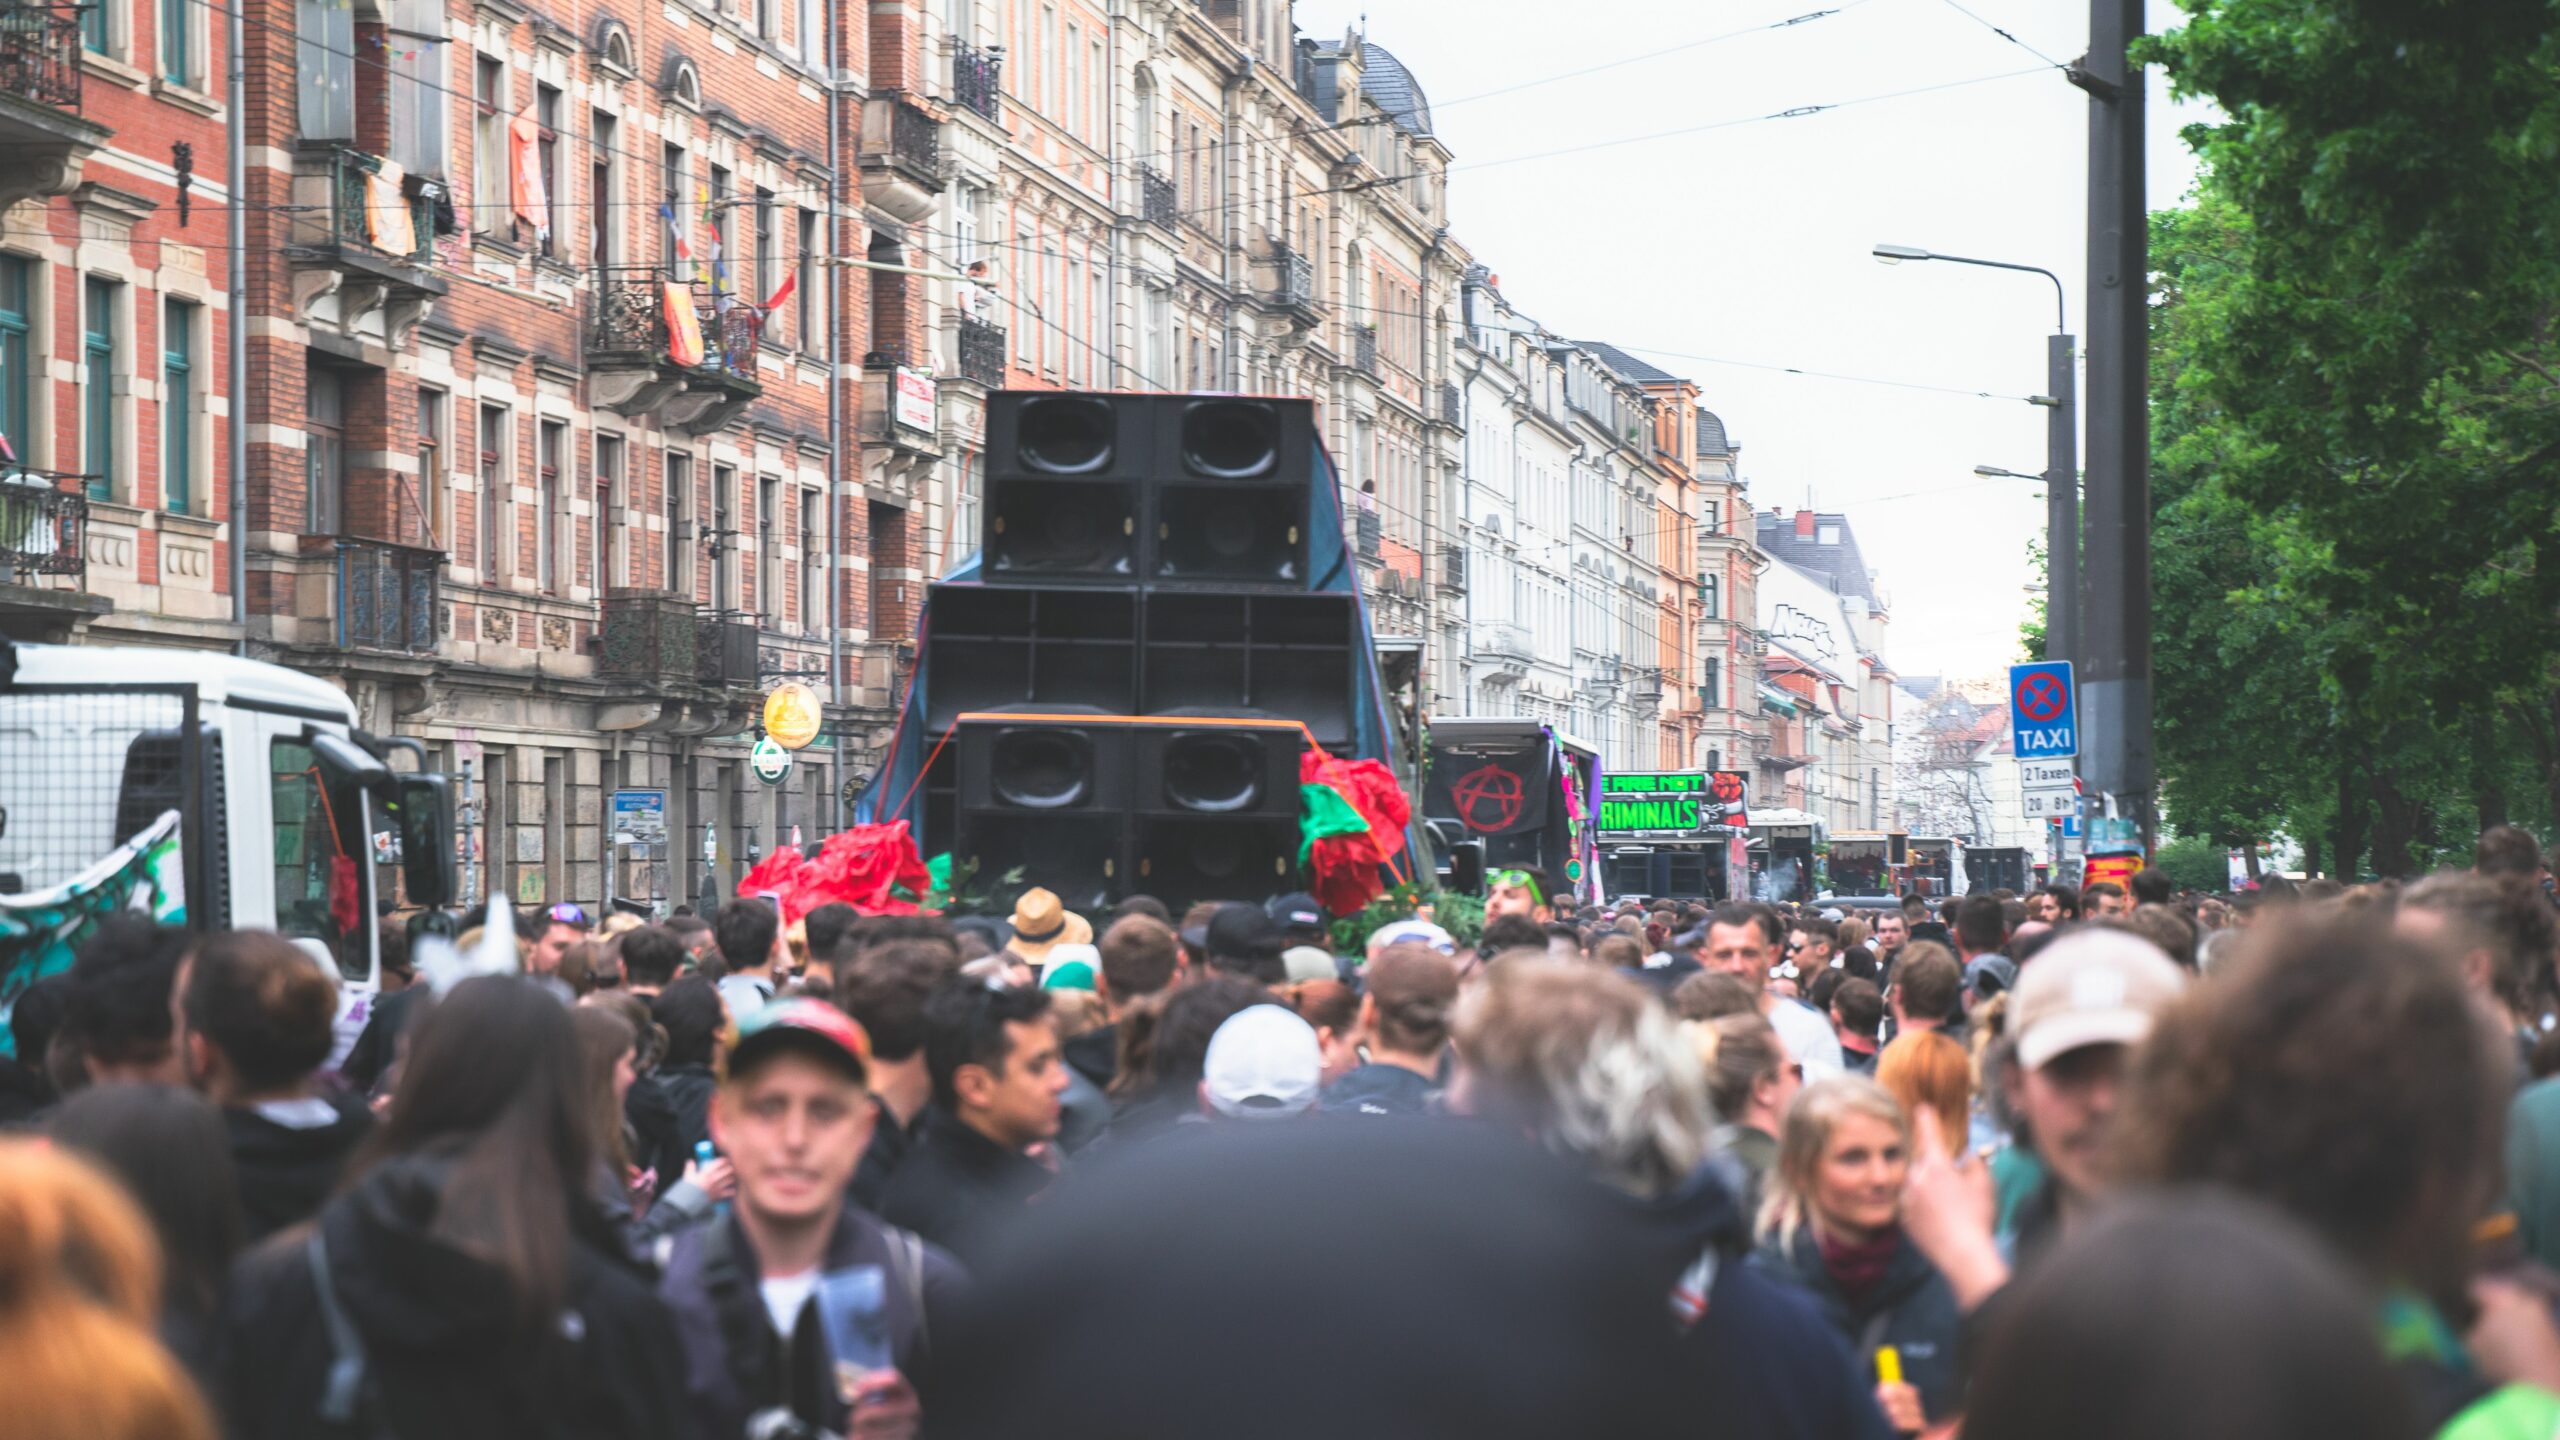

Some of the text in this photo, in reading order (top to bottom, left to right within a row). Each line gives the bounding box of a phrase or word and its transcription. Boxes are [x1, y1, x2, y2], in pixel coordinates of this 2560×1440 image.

[2018, 728, 2071, 750] TAXI
[2024, 767, 2070, 781] 2 Taxen
[1612, 775, 1656, 792] ARE
[1658, 775, 1704, 792] NOT
[2028, 798, 2042, 811] 20
[1600, 800, 1697, 829] RIMINALS
